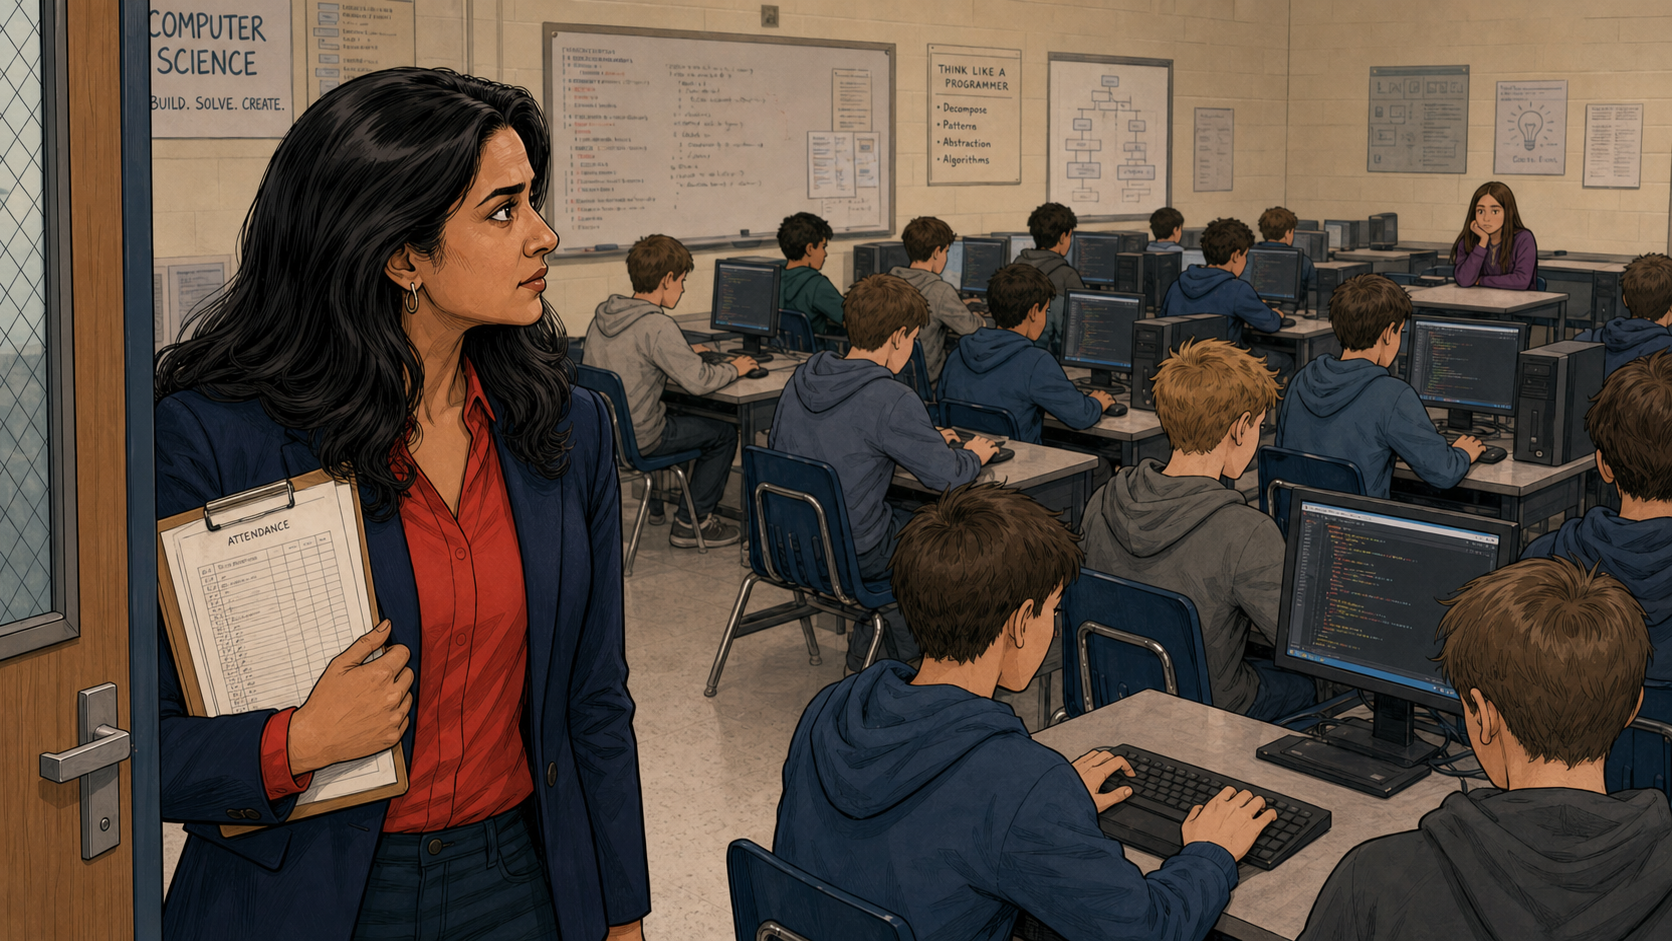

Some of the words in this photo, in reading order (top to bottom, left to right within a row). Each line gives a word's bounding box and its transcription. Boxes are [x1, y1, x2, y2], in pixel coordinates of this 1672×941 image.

[150, 9, 266, 42] COMPUTER
[157, 46, 257, 75] SCIENCE
[938, 64, 968, 75] THINK
[972, 66, 995, 77] LIKE
[998, 67, 1006, 77] A
[945, 78, 1009, 91] PROGRAMMER
[151, 95, 190, 110] BUILD.
[195, 96, 238, 111] SOLVE.
[242, 97, 285, 111] CREATE.
[943, 102, 987, 116] Decompose
[943, 137, 991, 148] Abstraction
[942, 154, 990, 167] Algorithms
[227, 519, 291, 547] ATTENDANCE
